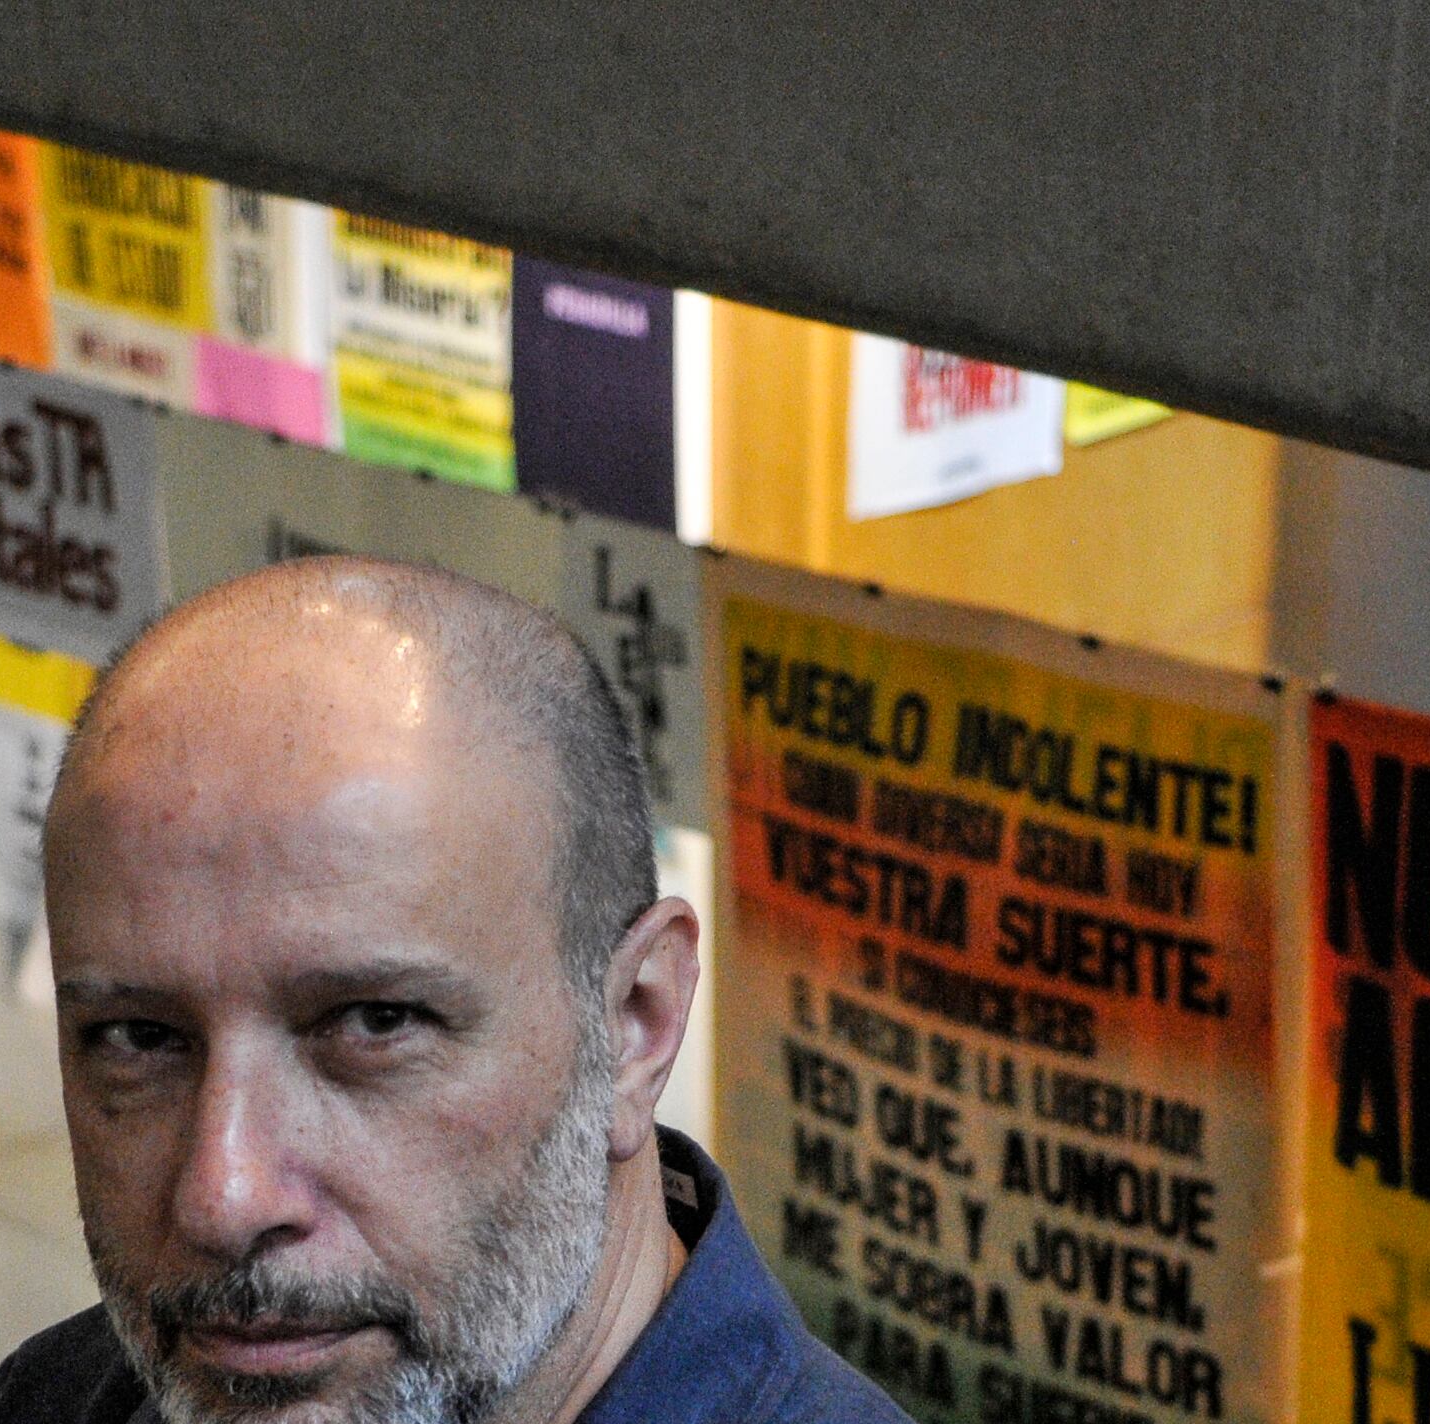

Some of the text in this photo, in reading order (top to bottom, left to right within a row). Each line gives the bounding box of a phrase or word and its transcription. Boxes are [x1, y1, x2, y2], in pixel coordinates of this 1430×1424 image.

[741, 644, 928, 768] PUEBLO
[955, 700, 1257, 853] INDOLENTE!
[764, 812, 969, 953] VUESTRA
[978, 1046, 1015, 1108] LA
[793, 1120, 937, 1246] MUJER
[961, 1193, 988, 1263] Y
[1001, 1127, 1217, 1252] AUNQUE
[781, 1200, 1223, 1421] ME SOBRA VALOR
[831, 1296, 957, 1411] PARA
